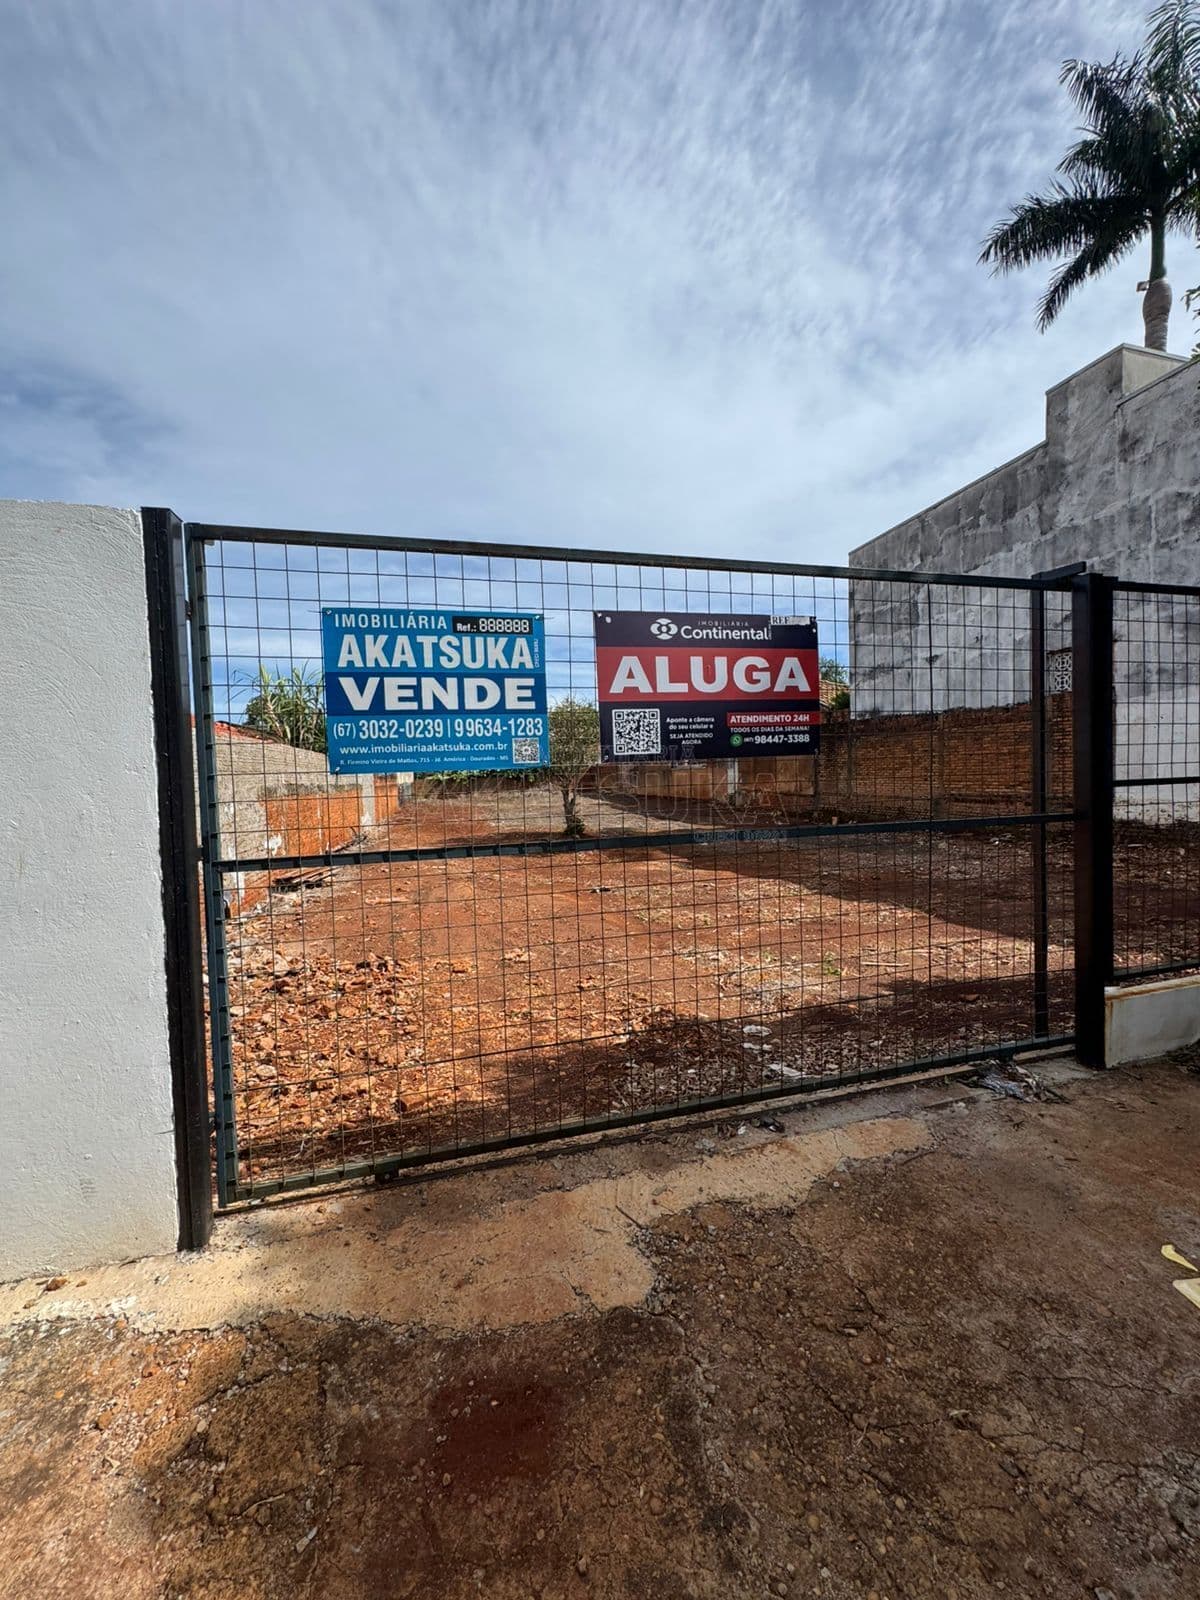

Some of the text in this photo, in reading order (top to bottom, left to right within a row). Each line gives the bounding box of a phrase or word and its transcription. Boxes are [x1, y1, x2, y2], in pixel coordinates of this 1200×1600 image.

[335, 612, 447, 630] IMOBILIÁRIA
[680, 625, 769, 641] Continental
[337, 634, 534, 670] AKATSUKA
[609, 655, 812, 694] ALUGA
[338, 677, 536, 711] VENDE
[730, 714, 810, 723] ATENDIMENTO 24H
[333, 723, 356, 739] (67)
[359, 719, 443, 739] 3032-0239
[340, 742, 508, 755] www.imobiliariaakatsuka.com.br
[754, 735, 810, 744] 98447-3388
